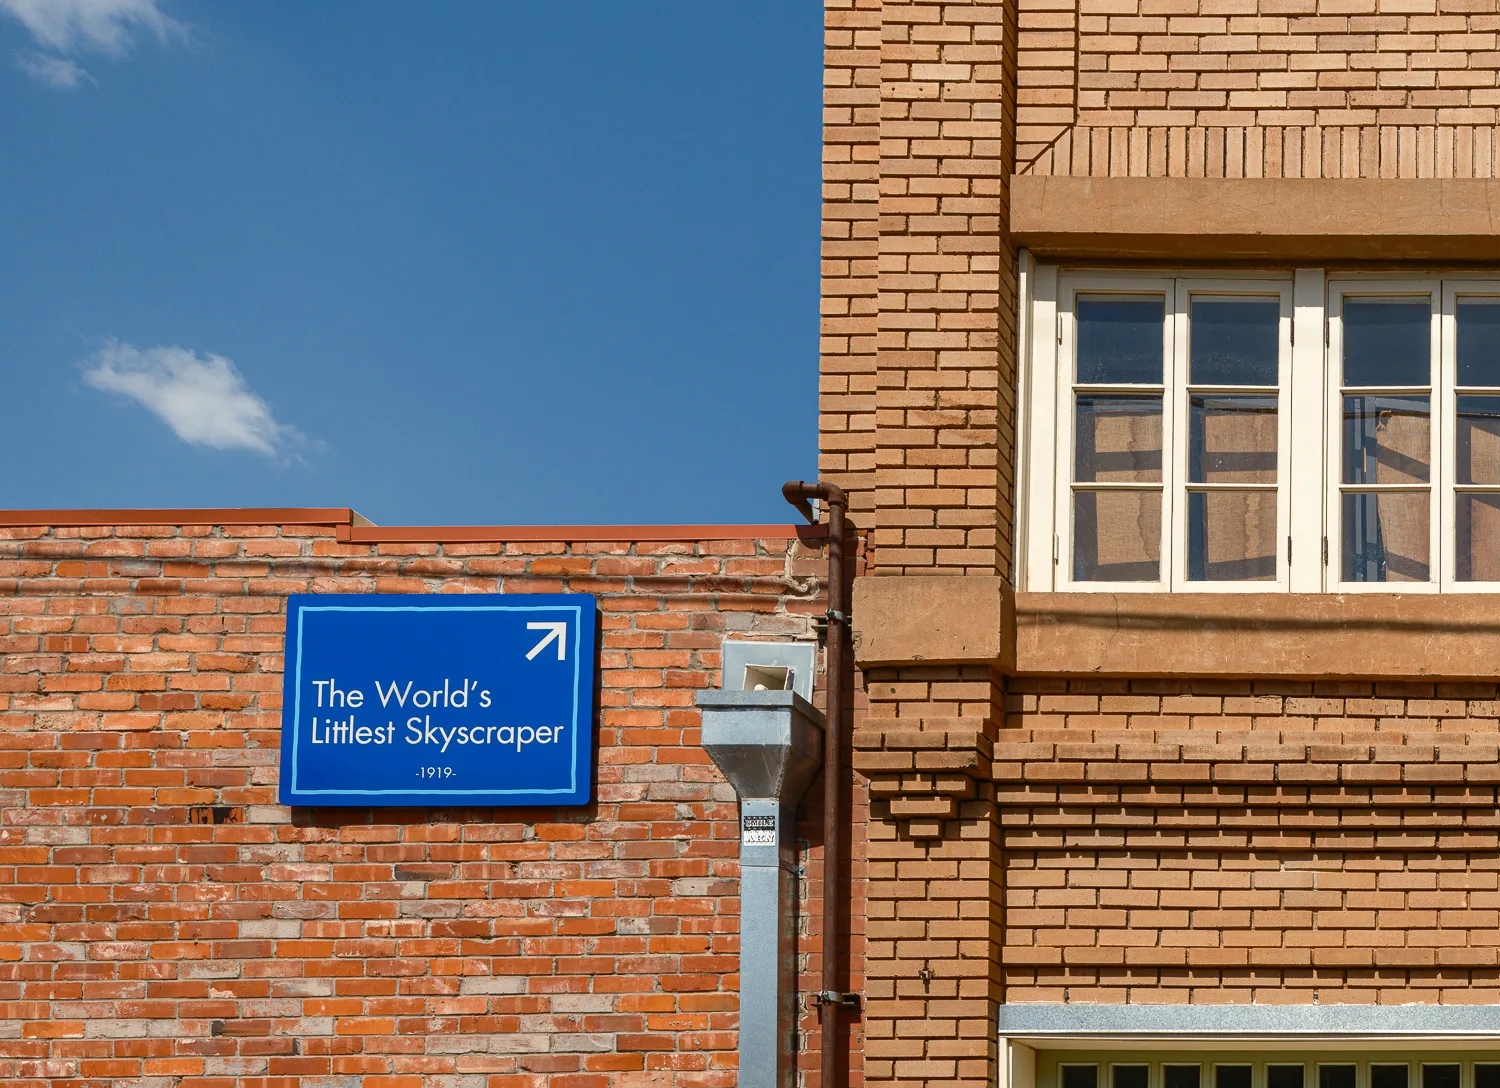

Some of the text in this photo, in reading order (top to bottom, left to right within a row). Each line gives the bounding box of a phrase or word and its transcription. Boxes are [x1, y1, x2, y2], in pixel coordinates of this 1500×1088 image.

[312, 678, 492, 709] The World's
[311, 714, 564, 753] Littlest Skyscraper
[744, 819, 775, 827] SMILE
